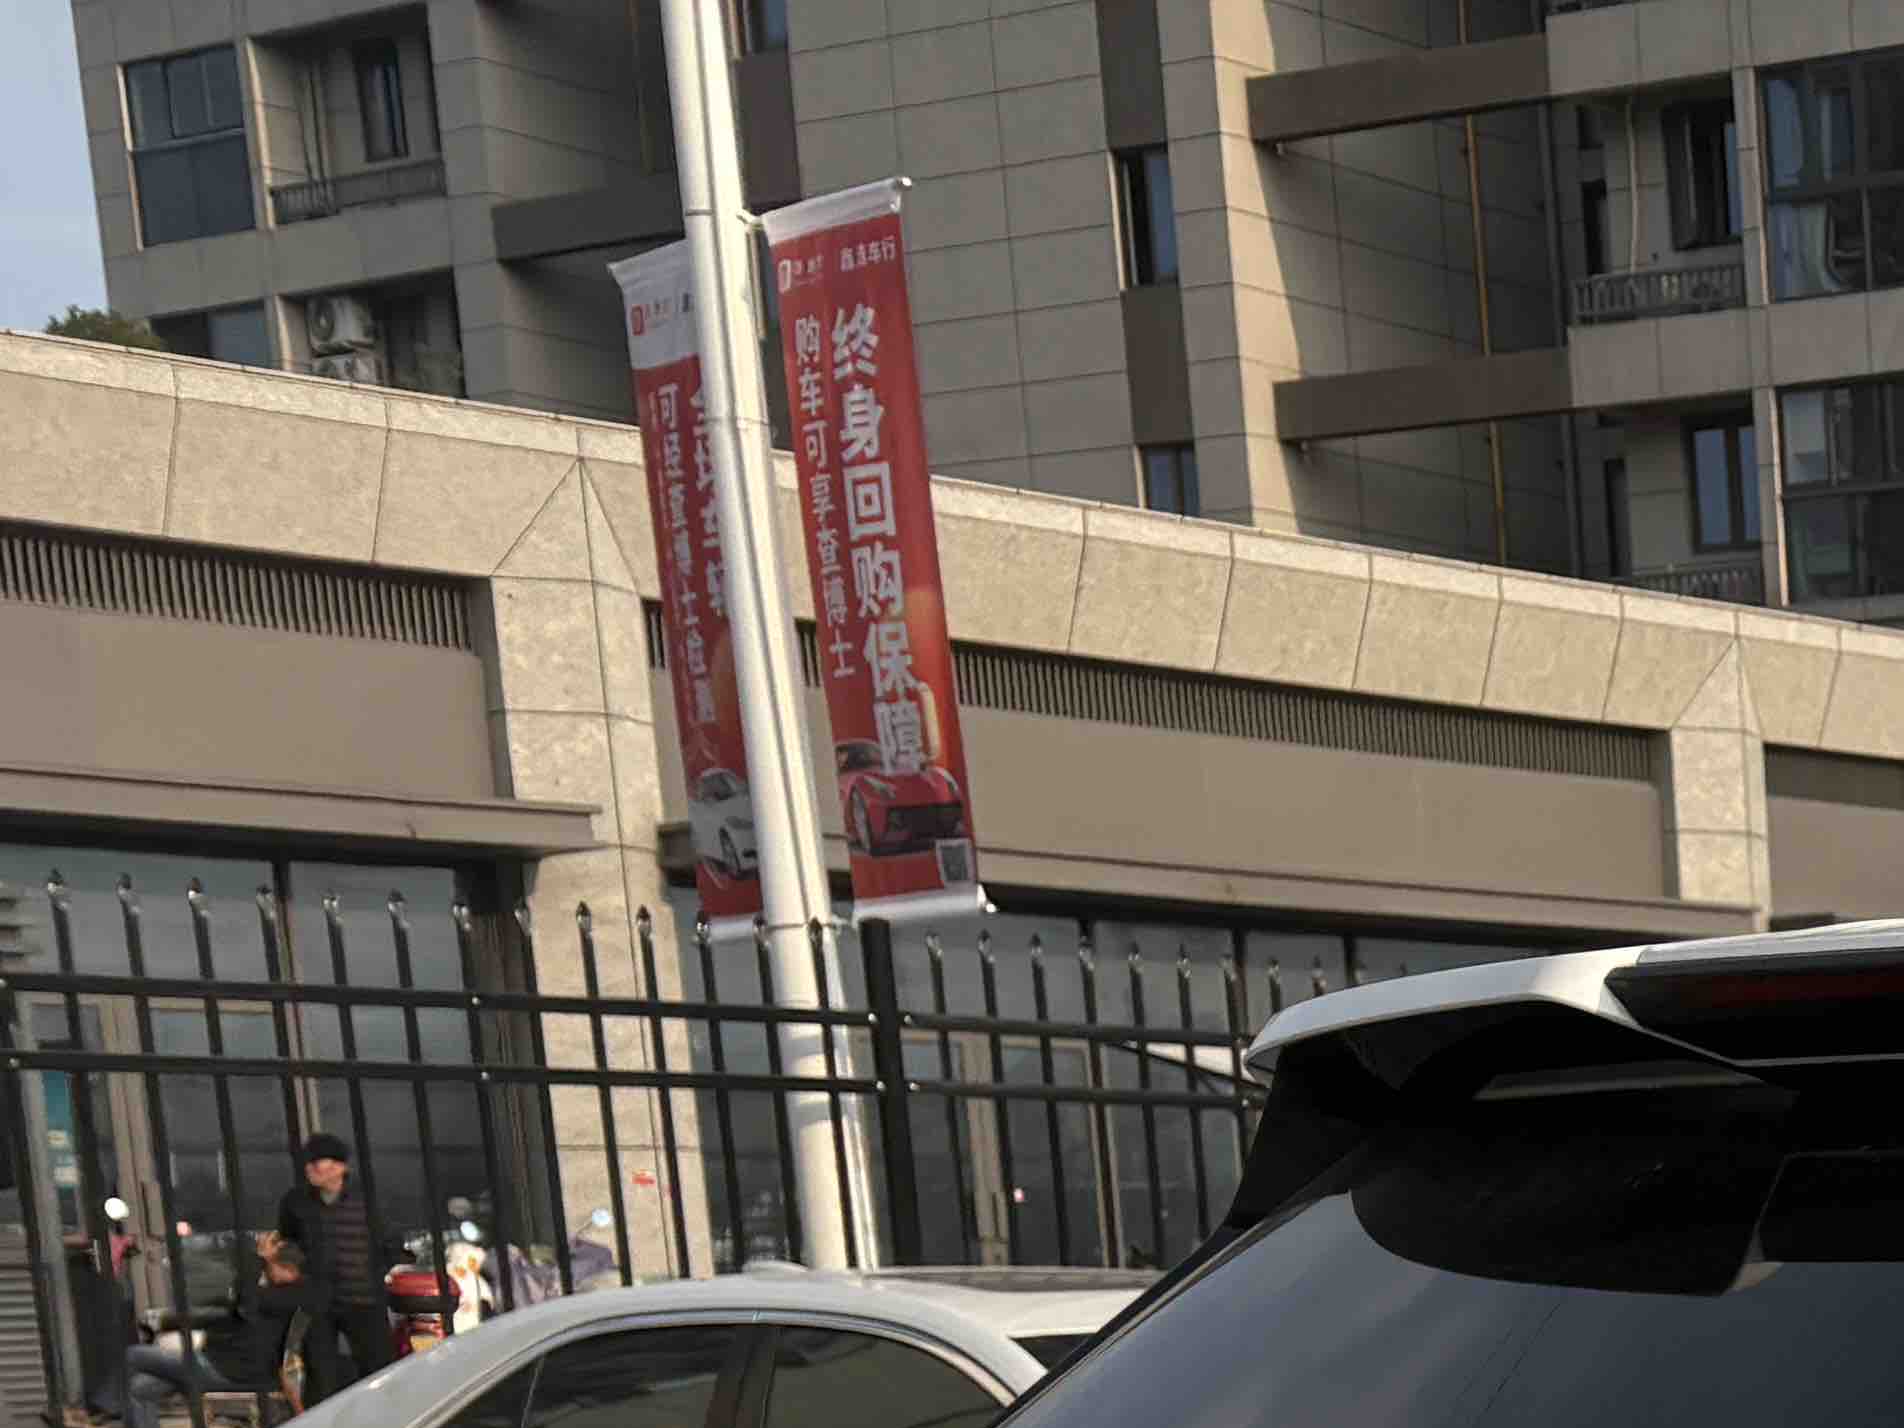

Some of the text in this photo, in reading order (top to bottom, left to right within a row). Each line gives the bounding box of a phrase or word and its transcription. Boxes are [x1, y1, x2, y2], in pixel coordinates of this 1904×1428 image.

[795, 314, 856, 678] 购车可享查博士
[831, 303, 924, 776] 终身回购保障
